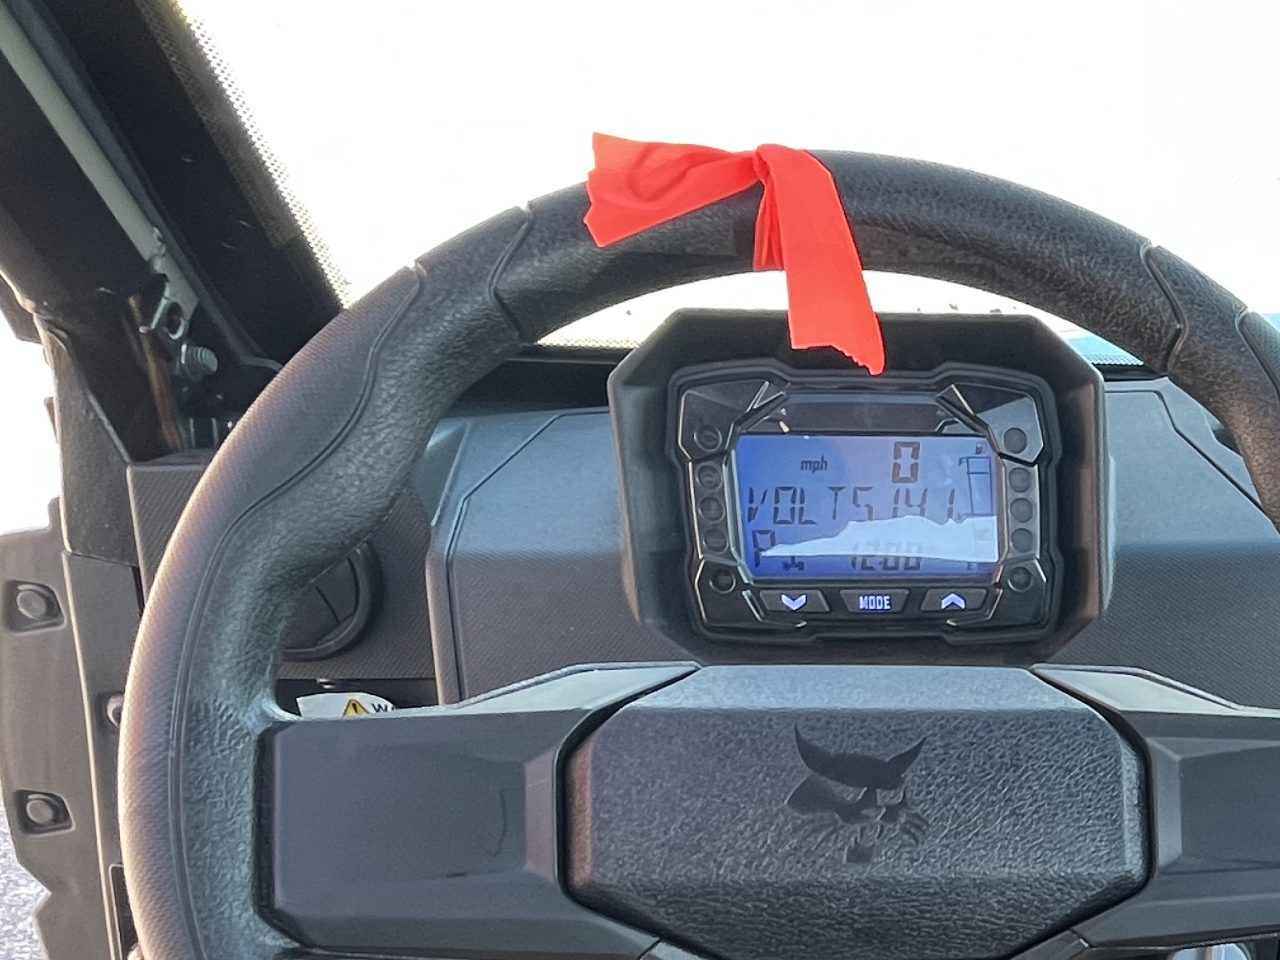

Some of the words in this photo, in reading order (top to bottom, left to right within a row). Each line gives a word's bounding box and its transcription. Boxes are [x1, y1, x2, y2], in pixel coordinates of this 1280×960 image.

[800, 456, 828, 474] mph
[891, 441, 921, 484] 0
[747, 486, 874, 525] VOLTS
[858, 595, 891, 610] MODE
